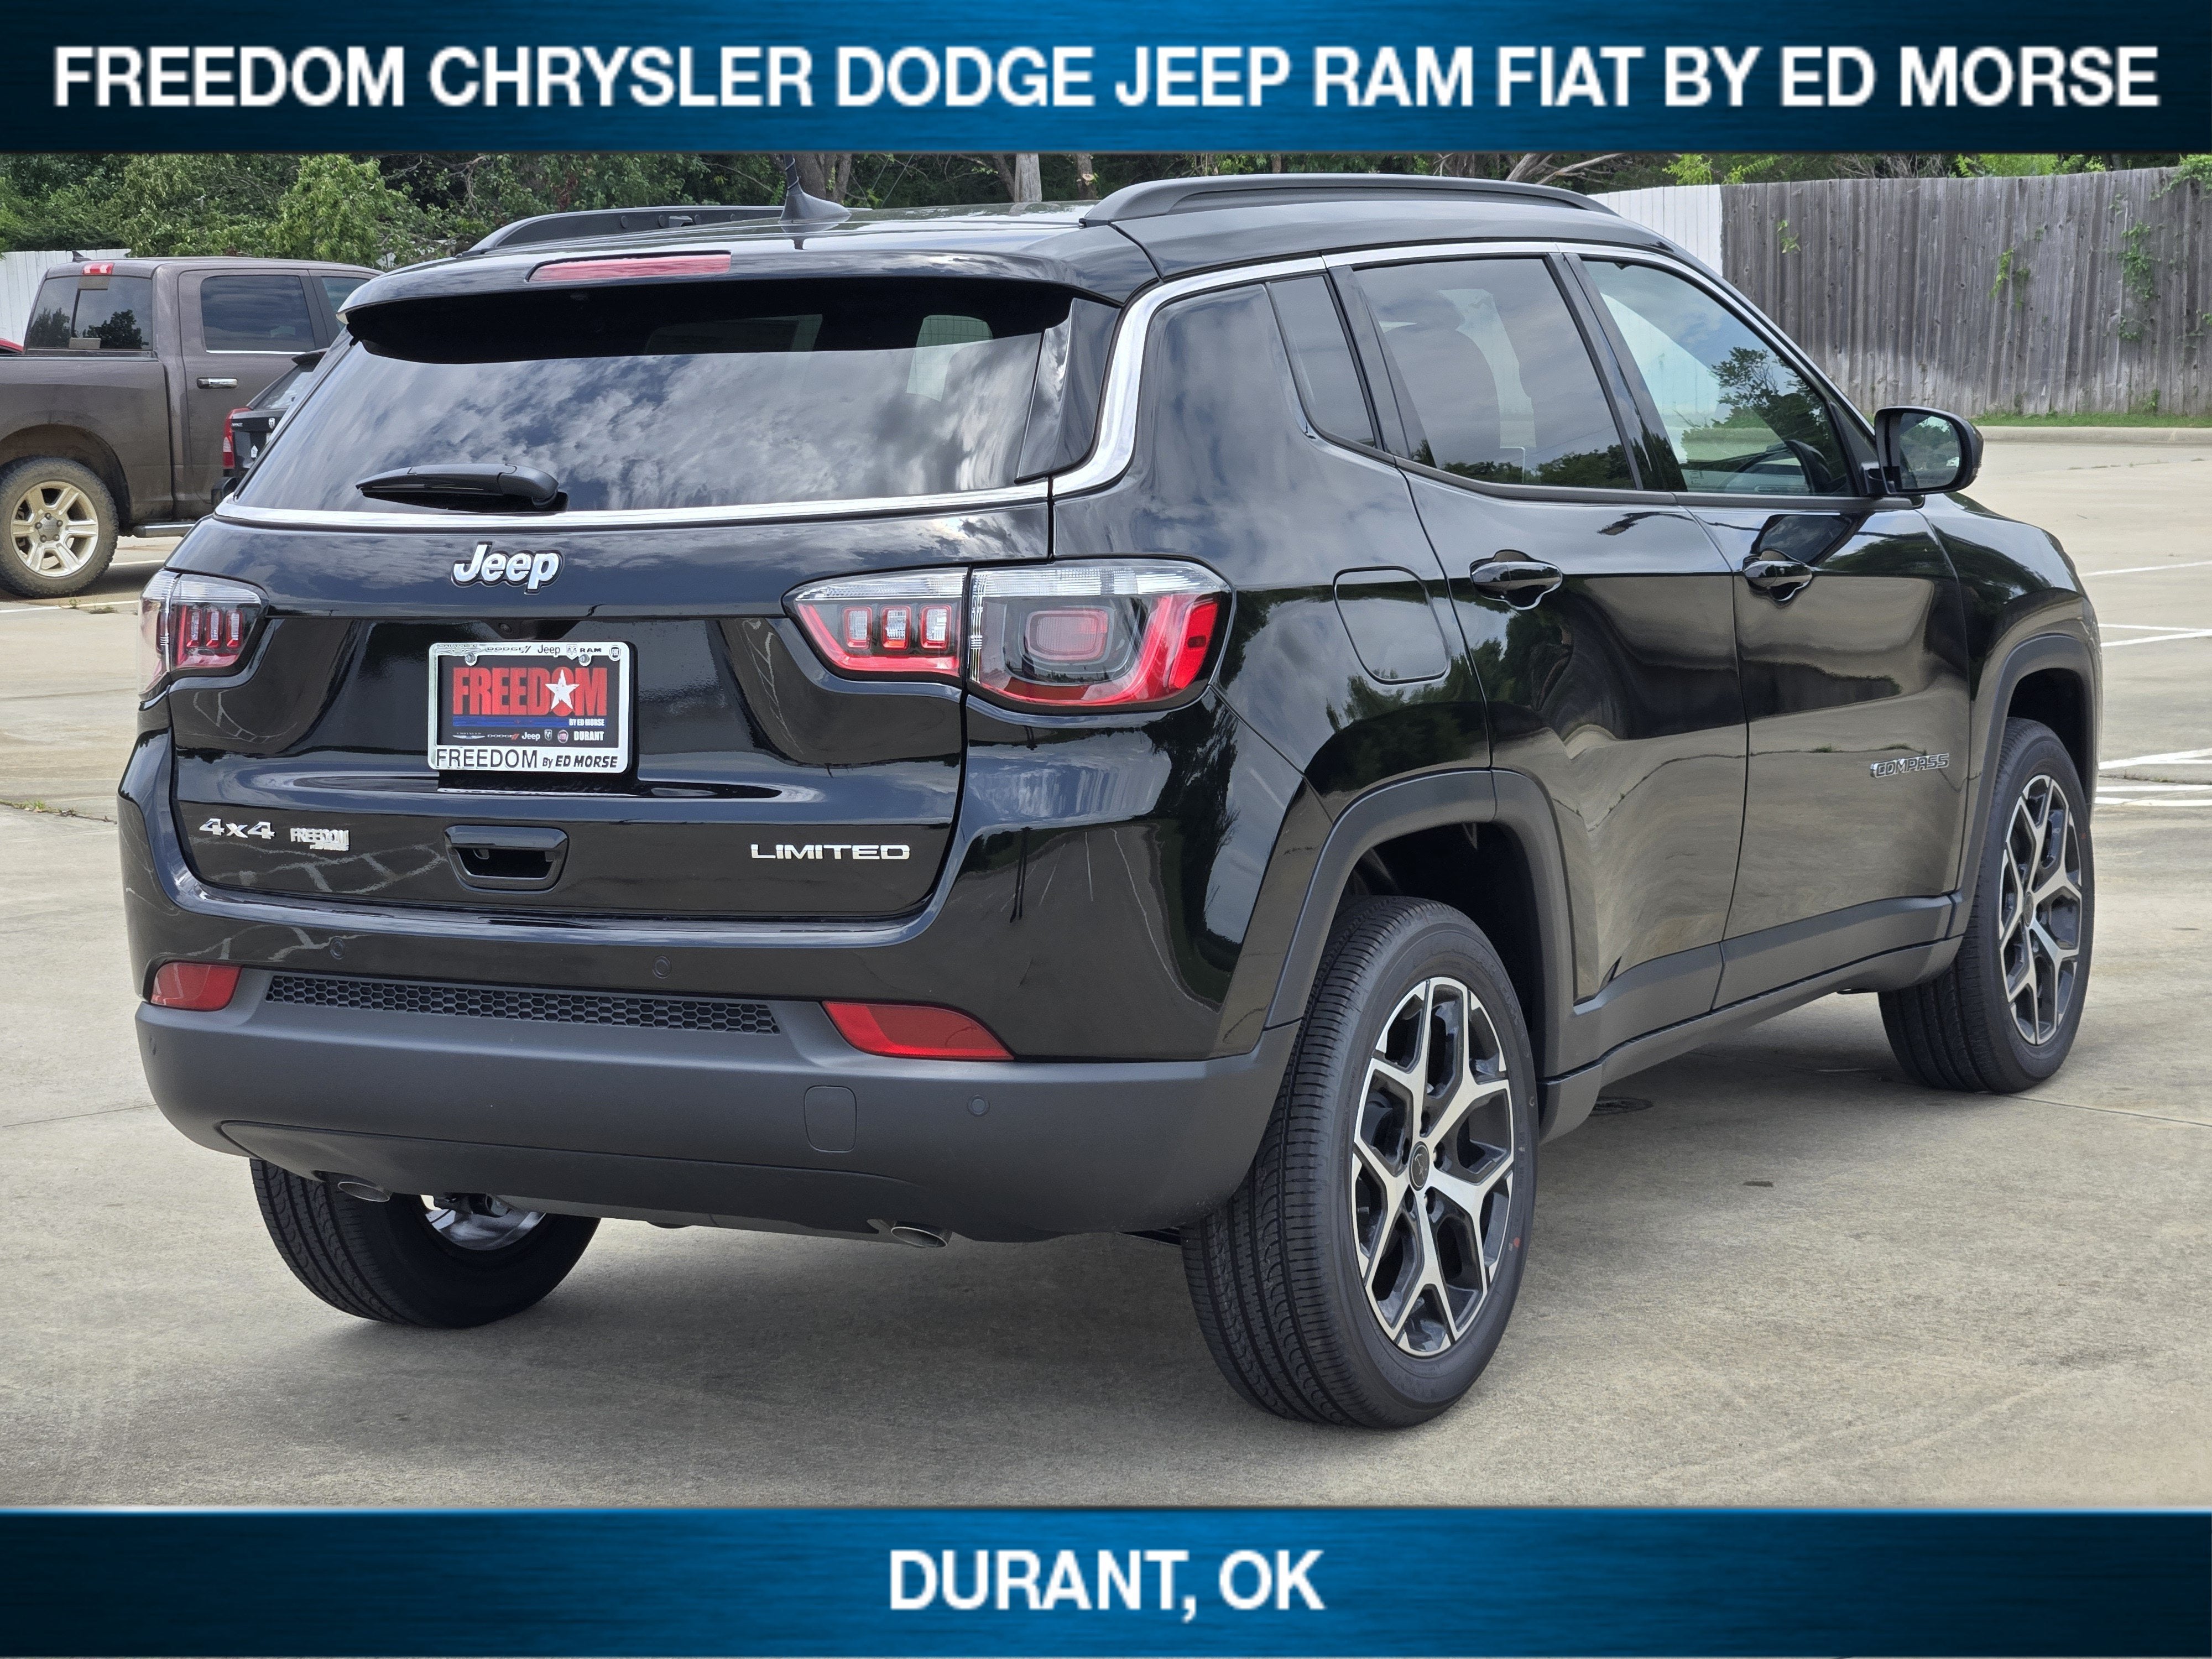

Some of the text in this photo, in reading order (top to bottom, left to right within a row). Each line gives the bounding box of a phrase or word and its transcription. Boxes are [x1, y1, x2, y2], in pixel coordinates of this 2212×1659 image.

[452, 542, 561, 593] Jeep
[538, 644, 561, 656] Jeep
[452, 666, 608, 717] FREEDOM
[585, 718, 605, 727] MORSE
[521, 732, 541, 742] Jeep
[573, 731, 605, 742] DURANT
[436, 748, 538, 769] FREEDOM
[555, 755, 570, 768] ED
[573, 755, 619, 768] MORSE
[1870, 752, 1949, 779] COMPASS
[199, 817, 275, 841] 4x4
[290, 827, 350, 844] FREEDOM
[750, 843, 910, 860] LIMITED
